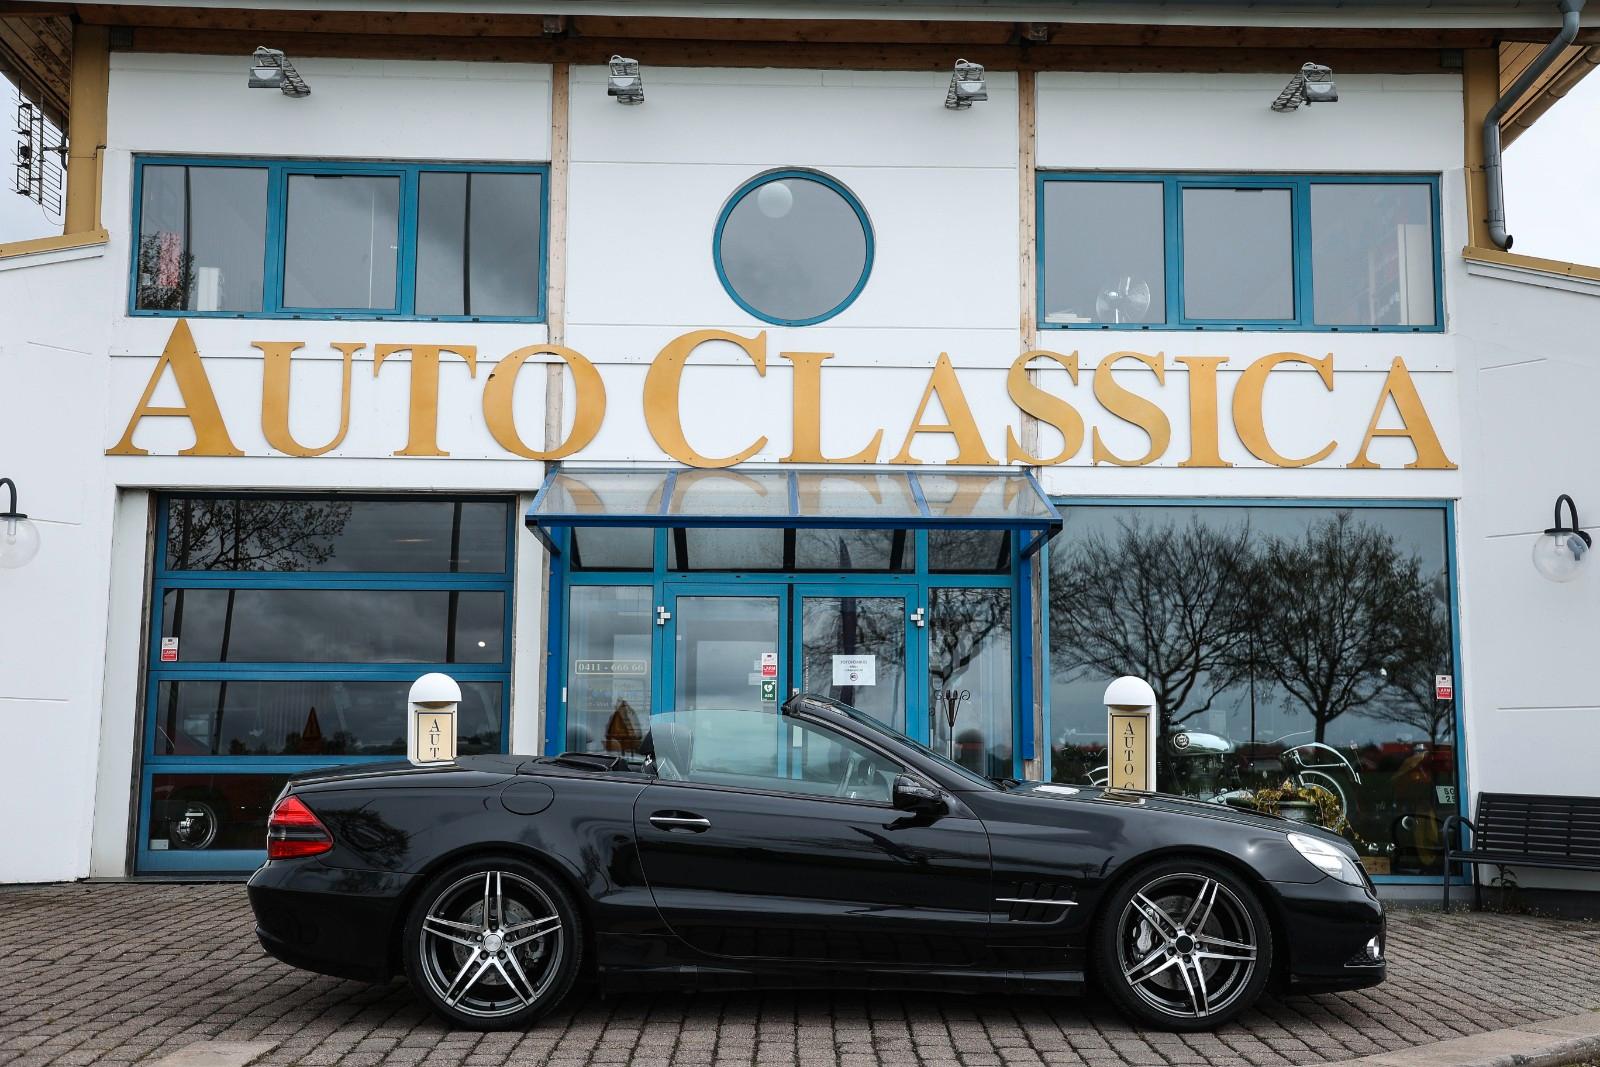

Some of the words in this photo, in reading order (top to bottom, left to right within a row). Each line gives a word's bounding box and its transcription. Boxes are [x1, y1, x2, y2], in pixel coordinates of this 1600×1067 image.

[104, 318, 607, 461] AUTO
[643, 328, 1459, 470] CLASSICA
[578, 663, 601, 671] 0411
[1124, 721, 1135, 776] AUTO
